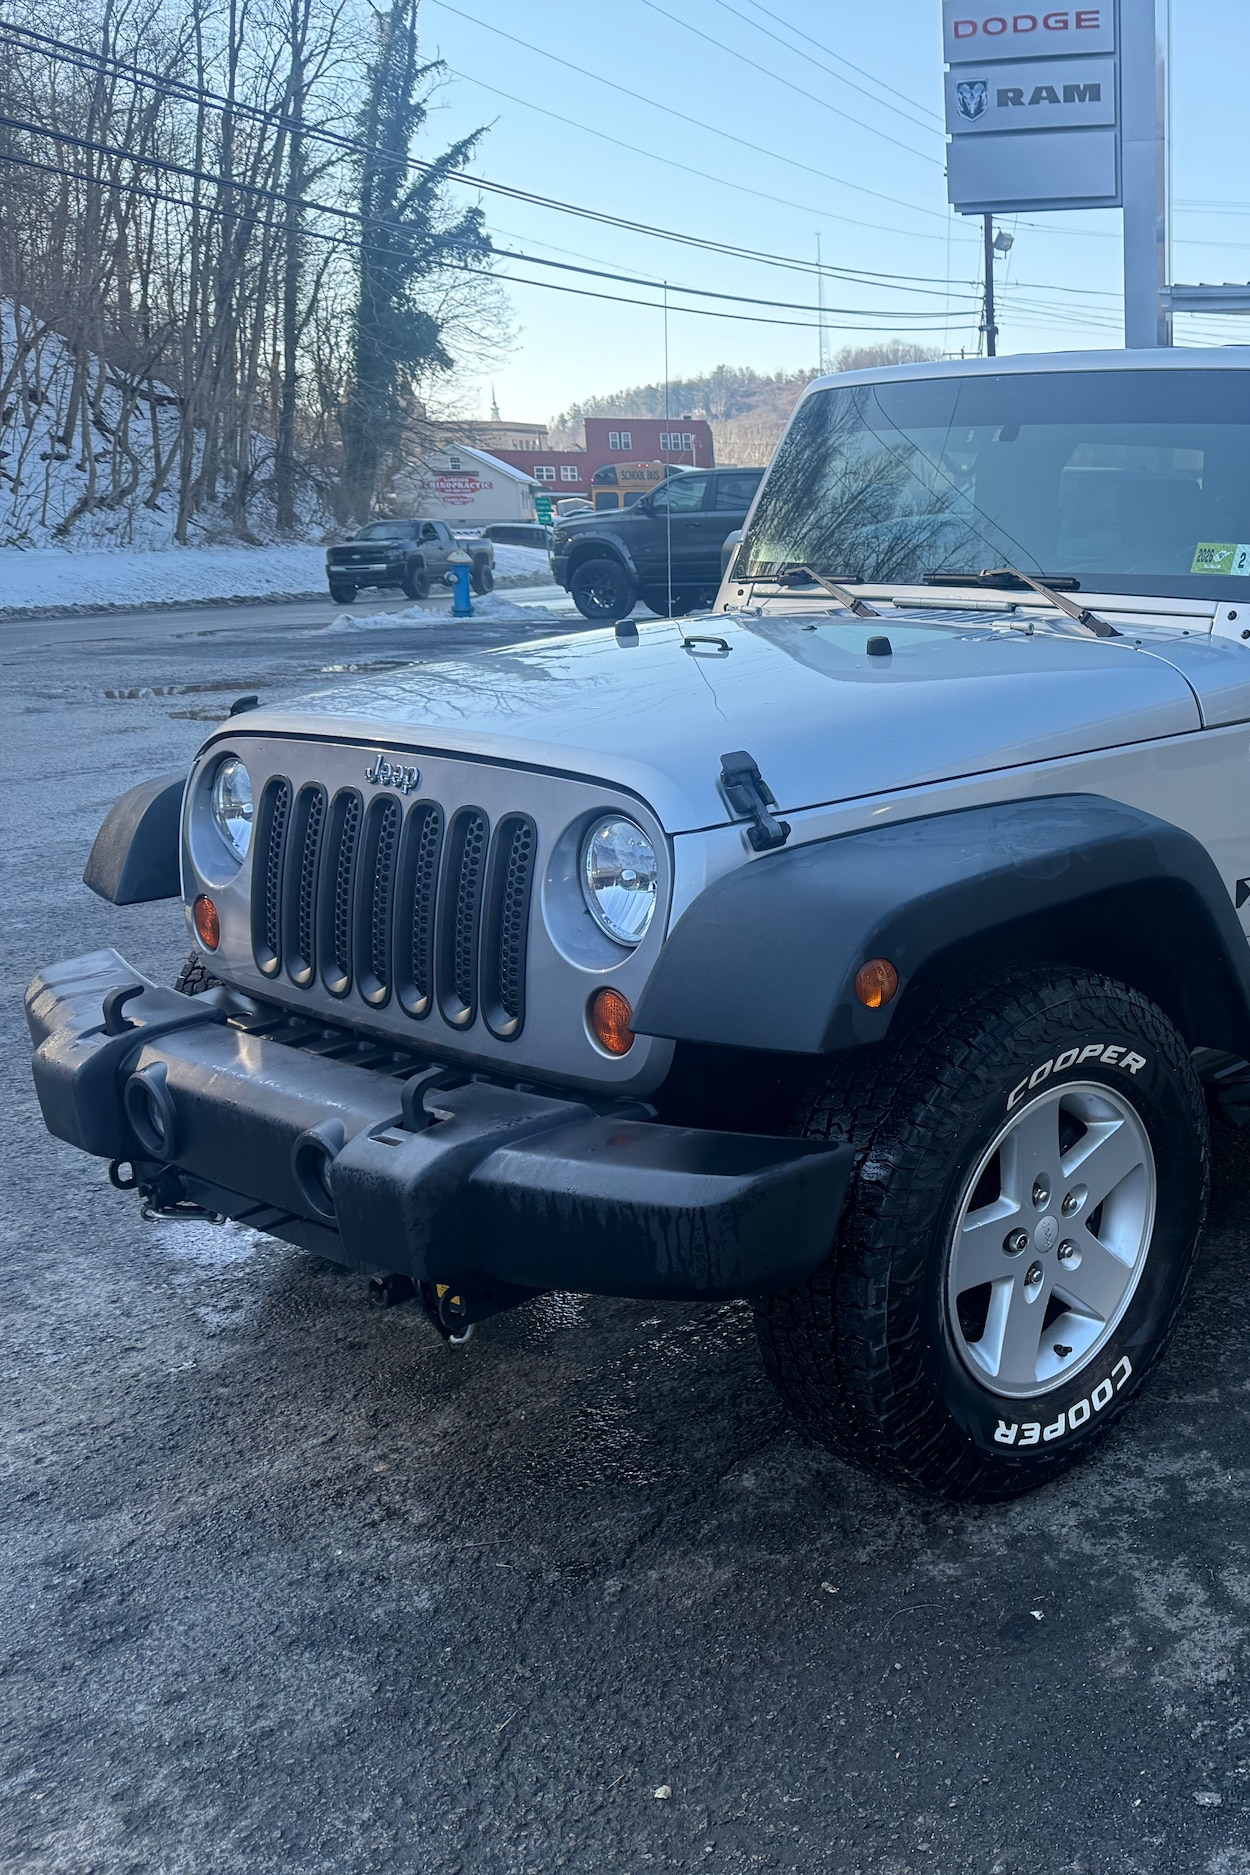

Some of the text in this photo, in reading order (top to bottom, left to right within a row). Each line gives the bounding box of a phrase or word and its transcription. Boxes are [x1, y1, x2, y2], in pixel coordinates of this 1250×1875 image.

[953, 10, 1101, 39] DODGE
[996, 83, 1102, 107] RAM
[621, 470, 660, 480] SCHOOL BUS
[1237, 552, 1247, 569] 2
[365, 754, 420, 795] Jeep
[1006, 1043, 1147, 1111] COOPER
[994, 1354, 1134, 1446] COOPER
